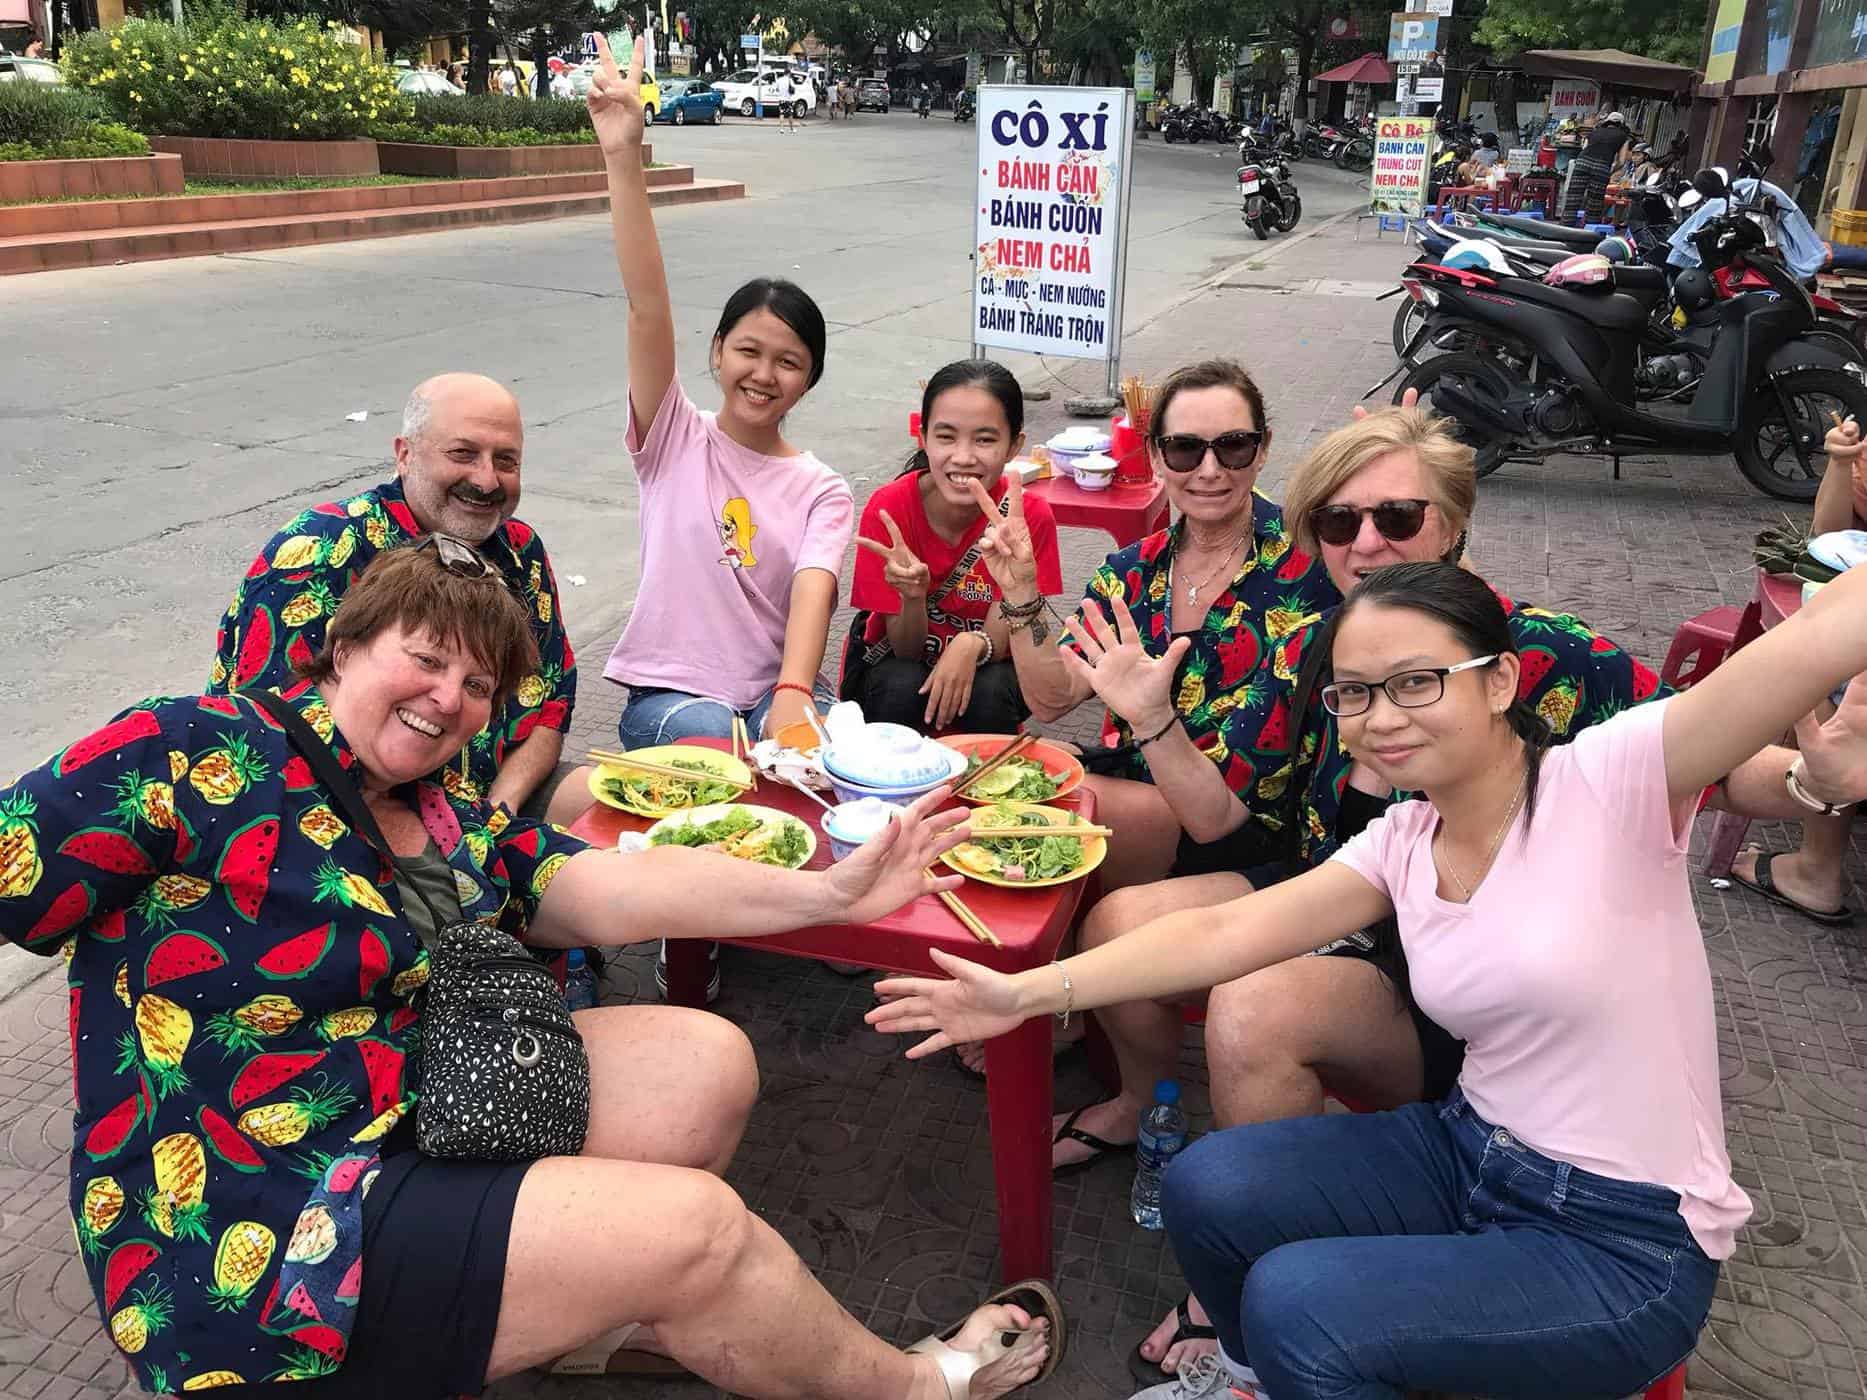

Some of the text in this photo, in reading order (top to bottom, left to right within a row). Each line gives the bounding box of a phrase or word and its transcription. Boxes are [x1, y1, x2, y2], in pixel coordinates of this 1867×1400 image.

[1402, 21, 1424, 49] P
[991, 99, 1109, 151] CÔ XÍ
[998, 155, 1050, 191] BÁNH
[991, 194, 1102, 235] BÁNH CUỐN
[997, 236, 1092, 274] NEM CHẢ
[1040, 283, 1064, 304] NEM
[979, 302, 1015, 333] BÁNH
[1068, 313, 1105, 348] TRỘN
